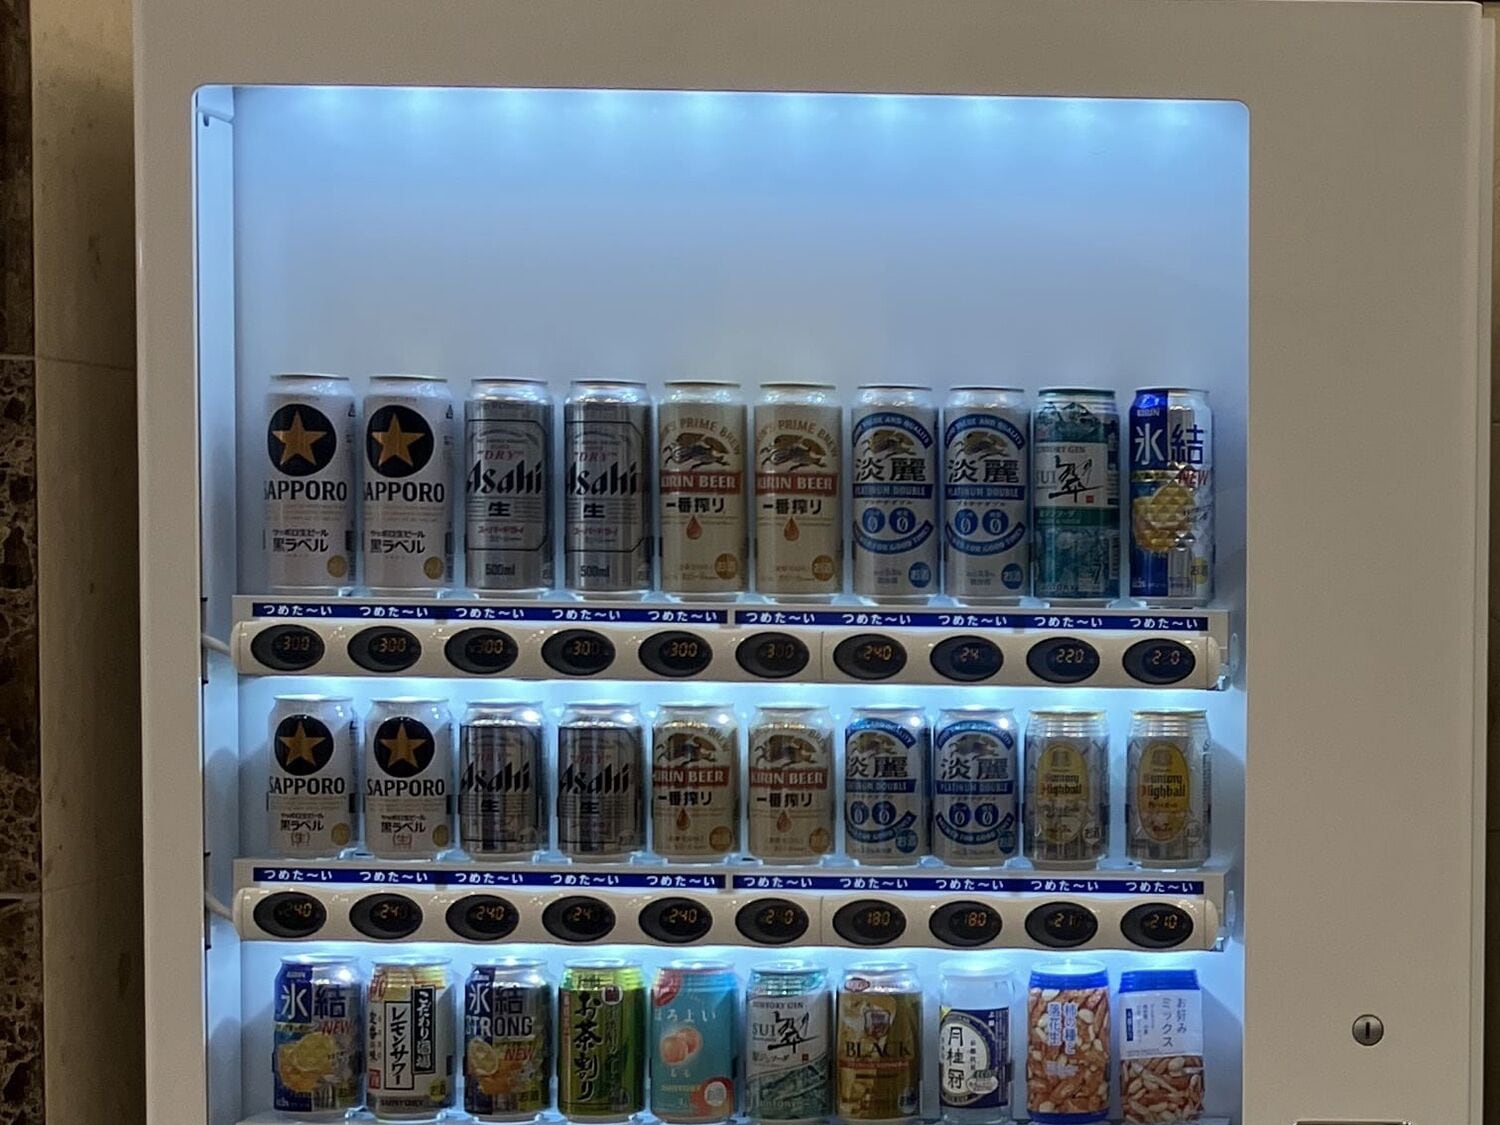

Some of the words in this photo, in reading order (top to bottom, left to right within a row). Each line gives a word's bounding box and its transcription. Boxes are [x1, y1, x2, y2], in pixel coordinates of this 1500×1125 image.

[1135, 423, 1204, 464] 氷結
[467, 460, 542, 494] Asahi
[856, 458, 926, 481] 淡麗
[948, 459, 1019, 483] 淡麗
[700, 475, 735, 488] BEER
[797, 477, 833, 490] BEER
[488, 501, 511, 516] 生
[583, 503, 606, 518] 生
[666, 497, 725, 514] 一番搾り
[763, 499, 822, 515] 一番搾り
[273, 538, 328, 553] 黒ラベル
[370, 539, 425, 553] 黒ラベル
[1056, 648, 1085, 663] 220
[941, 758, 1009, 779] 淡麗
[461, 762, 530, 792] Asahi
[560, 763, 629, 794] Asahi
[688, 771, 723, 782] BEER
[789, 772, 823, 784] BEER
[367, 779, 445, 796] SAPPORO
[658, 791, 712, 806] 一番搾り
[757, 793, 812, 807] 一番搾り
[280, 819, 324, 831] 黒ラベル
[381, 822, 426, 833] 黒ラベル
[669, 908, 697, 923] 240
[281, 983, 345, 1020] 氷結
[322, 1021, 351, 1035] NEW
[1162, 998, 1173, 1047] ミックス
[390, 1007, 408, 1085] レモンサワー
[574, 992, 602, 1102] お茶割り
[845, 1041, 910, 1058] BLACK
[504, 1048, 533, 1061] NEW
[947, 1026, 965, 1089] 月桂冠
